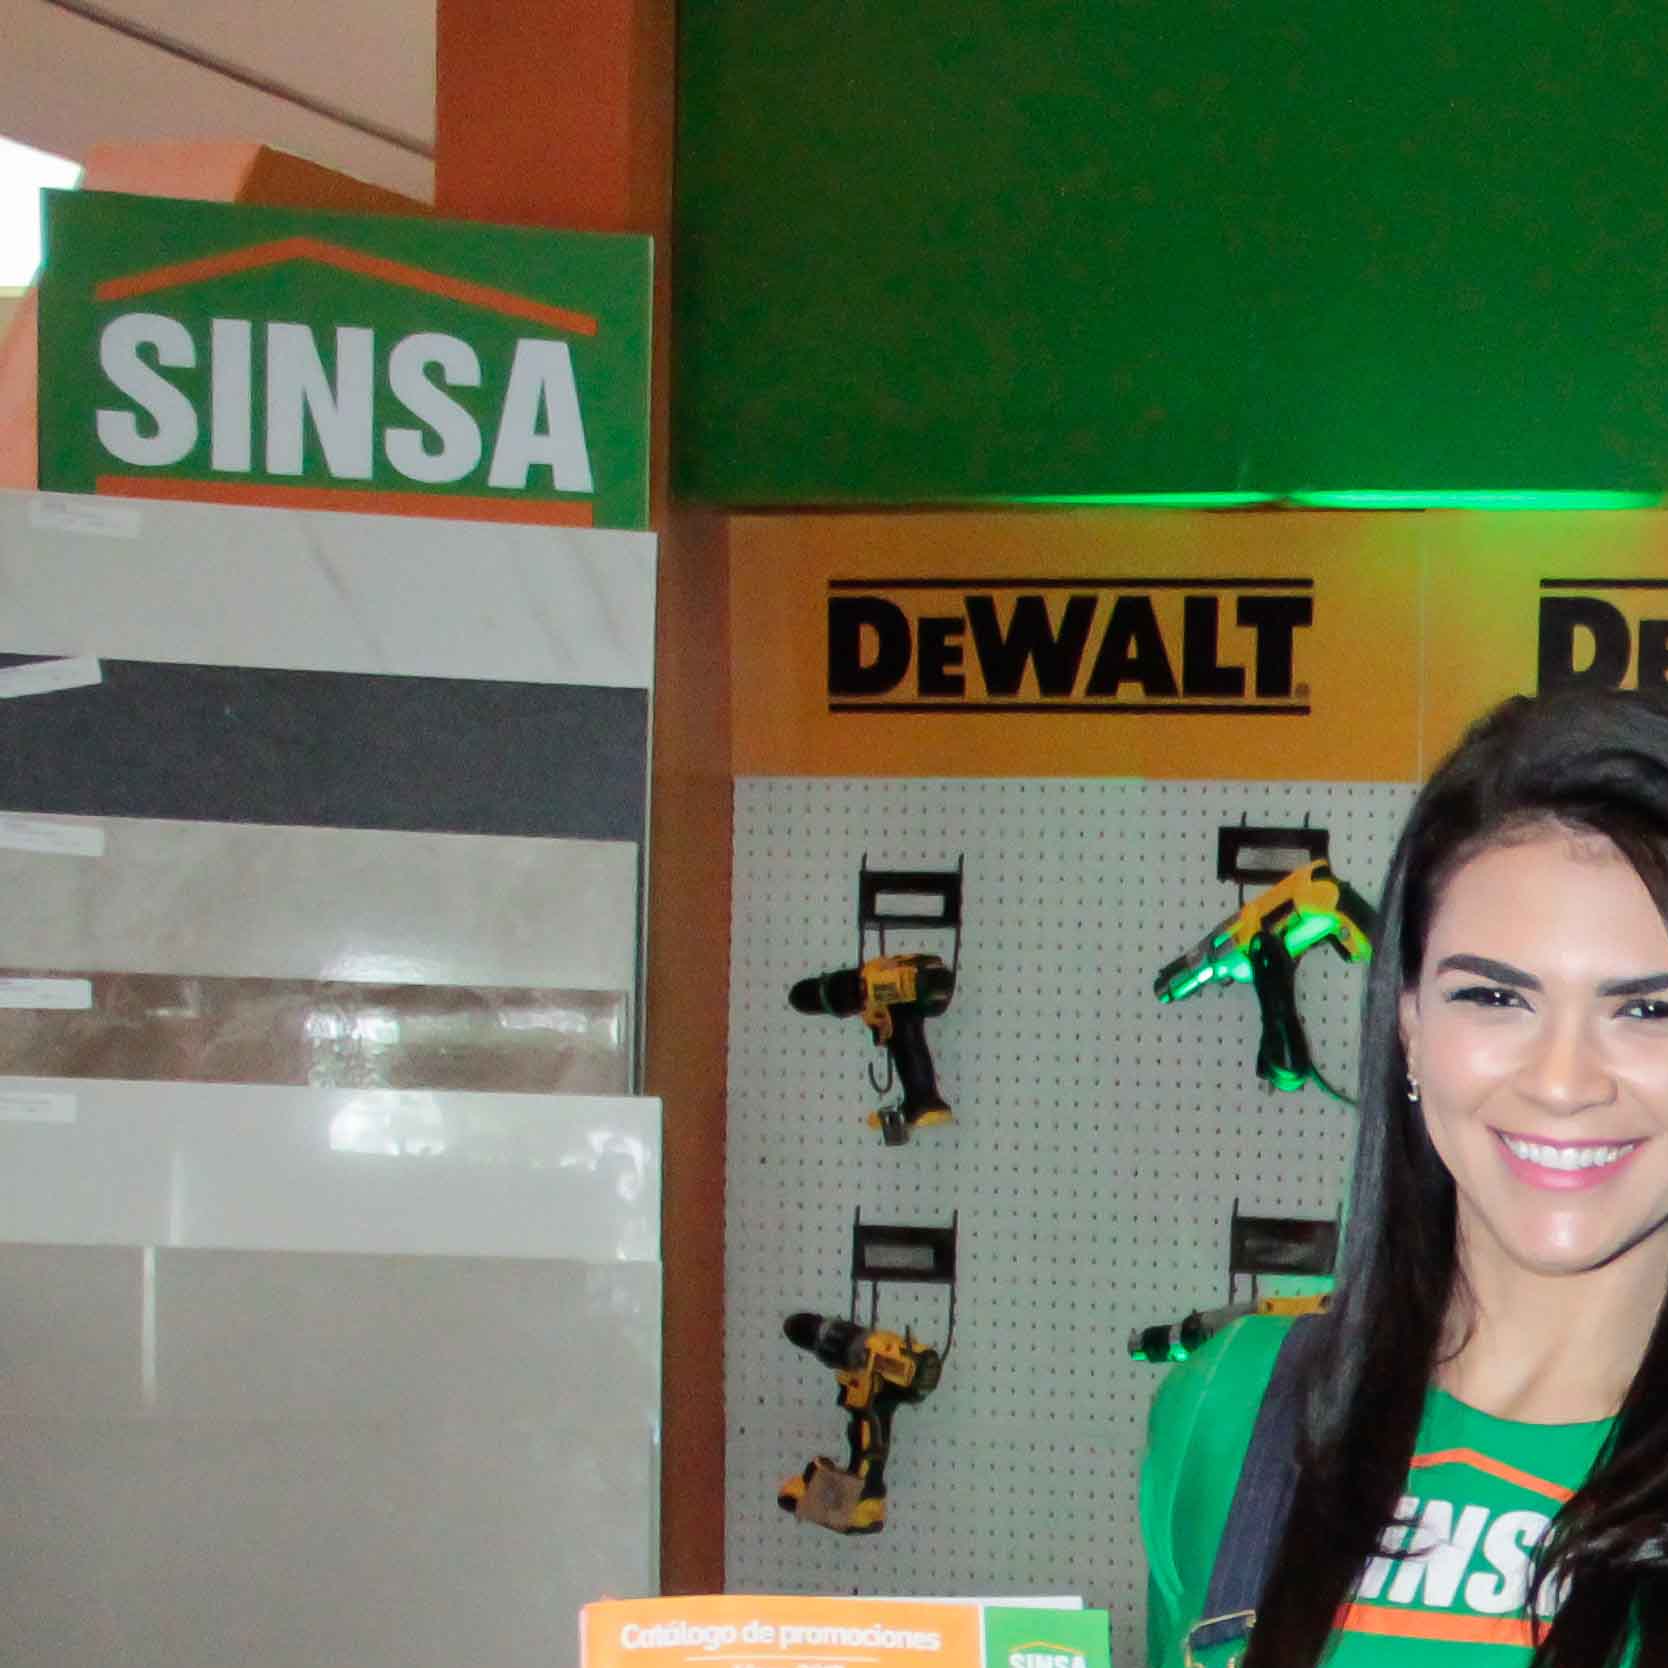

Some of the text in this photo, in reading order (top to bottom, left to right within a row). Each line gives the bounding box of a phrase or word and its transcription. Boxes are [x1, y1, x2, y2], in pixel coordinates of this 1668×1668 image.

[96, 313, 595, 495] SINSA
[620, 1620, 941, 1652] Catálogo de promociones
